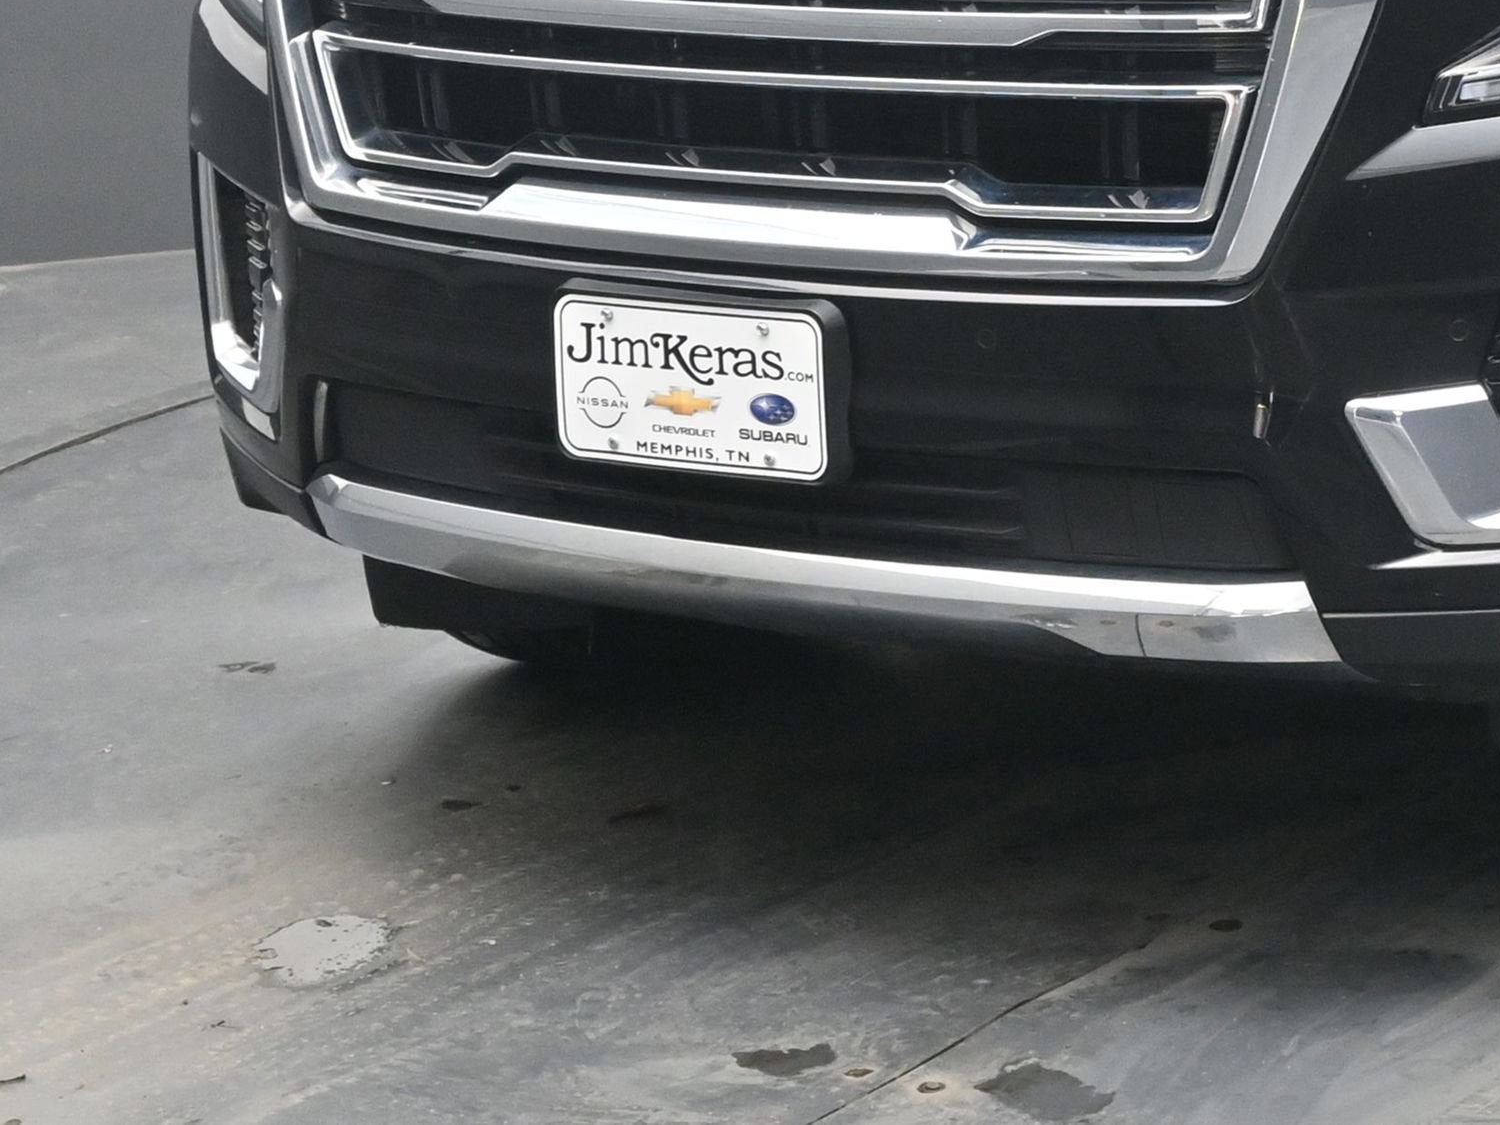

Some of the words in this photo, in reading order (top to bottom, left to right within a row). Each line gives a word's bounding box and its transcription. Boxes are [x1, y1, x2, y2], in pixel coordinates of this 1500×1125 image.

[577, 396, 629, 410] NISSAN
[652, 424, 715, 437] CHEVROLET
[739, 428, 807, 445] SUBARU
[636, 441, 719, 461] MEMPHIS,
[726, 450, 750, 463] TN
